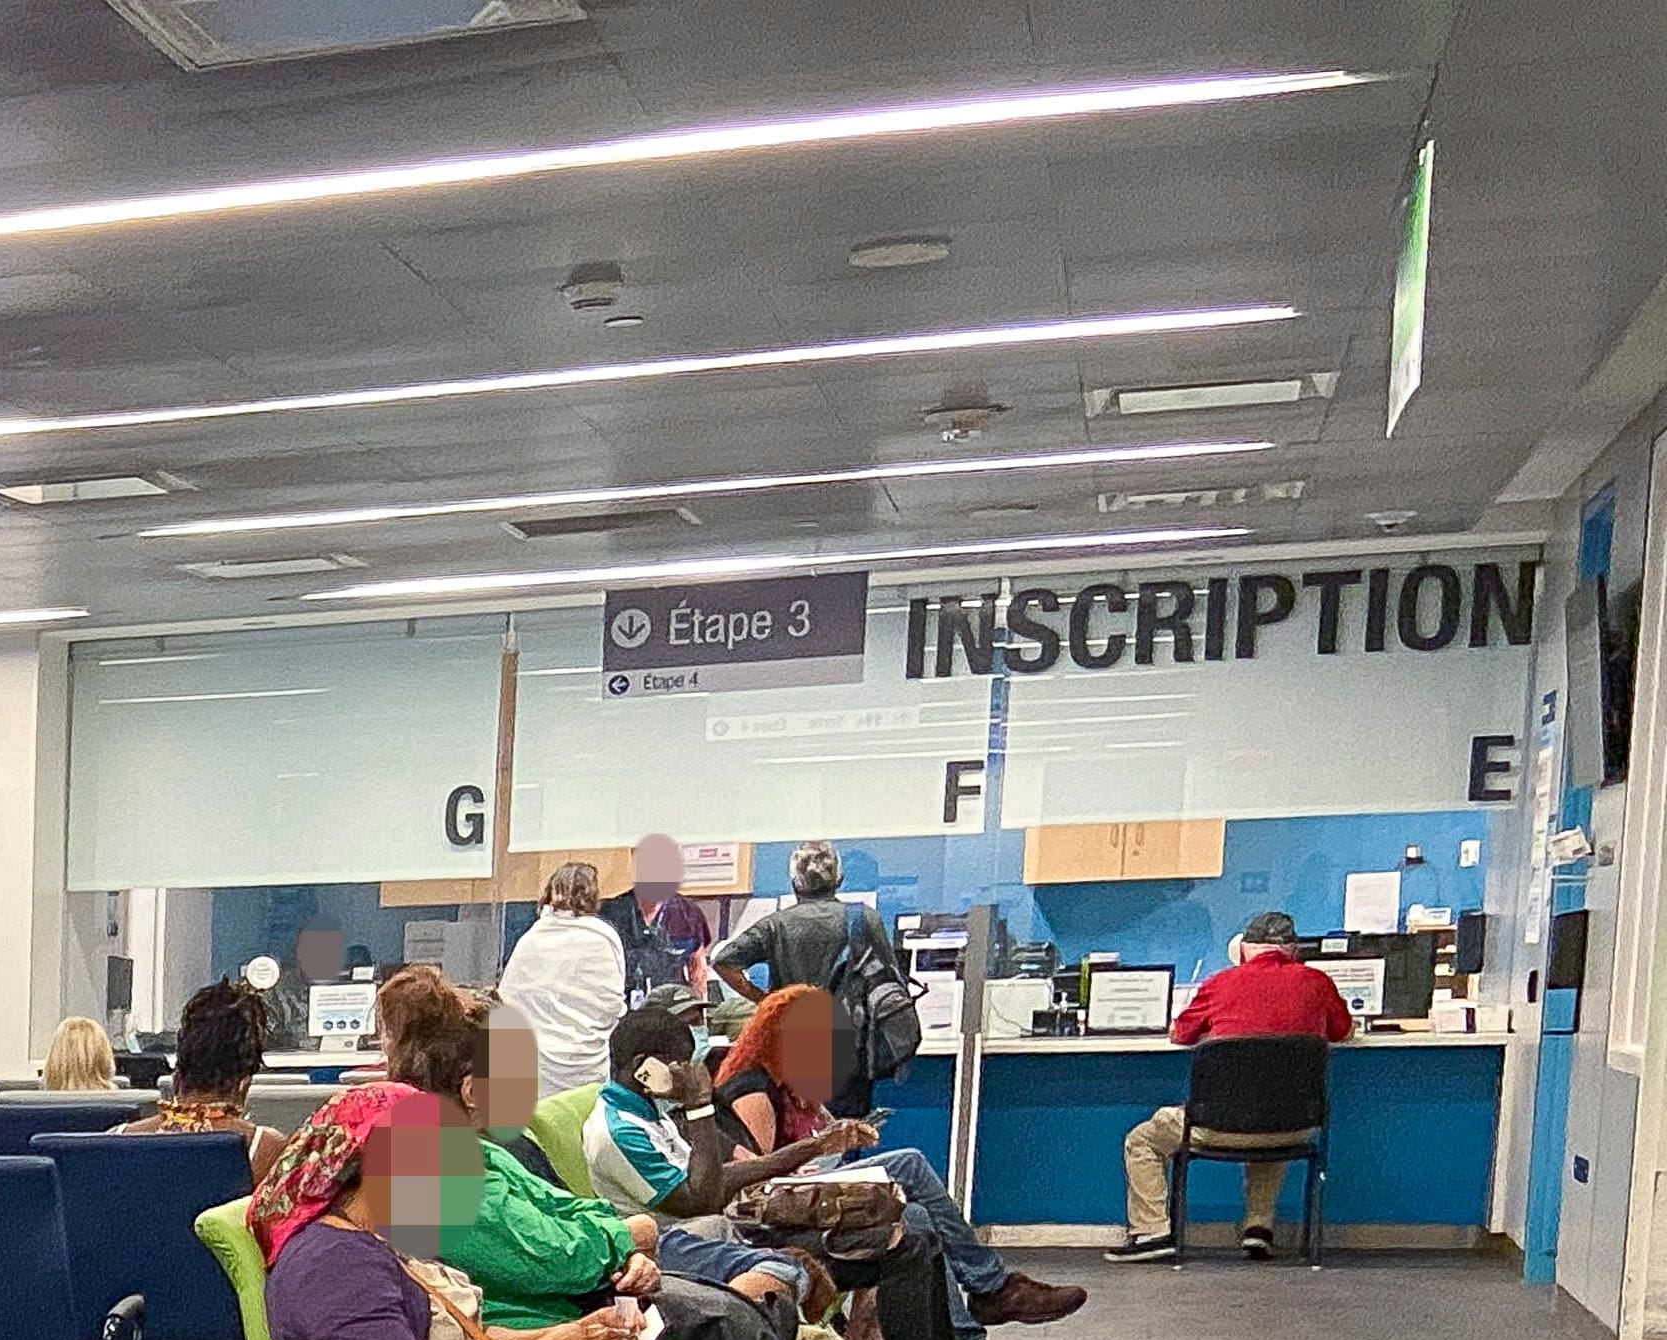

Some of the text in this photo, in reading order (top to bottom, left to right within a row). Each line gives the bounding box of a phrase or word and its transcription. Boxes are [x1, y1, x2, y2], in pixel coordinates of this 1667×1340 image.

[668, 599, 811, 650] Étape 3
[905, 560, 1538, 680] INSCRIPTION
[643, 671, 699, 693] Étape 4
[943, 760, 985, 823] F
[1467, 734, 1516, 802] E
[443, 784, 485, 846] G
